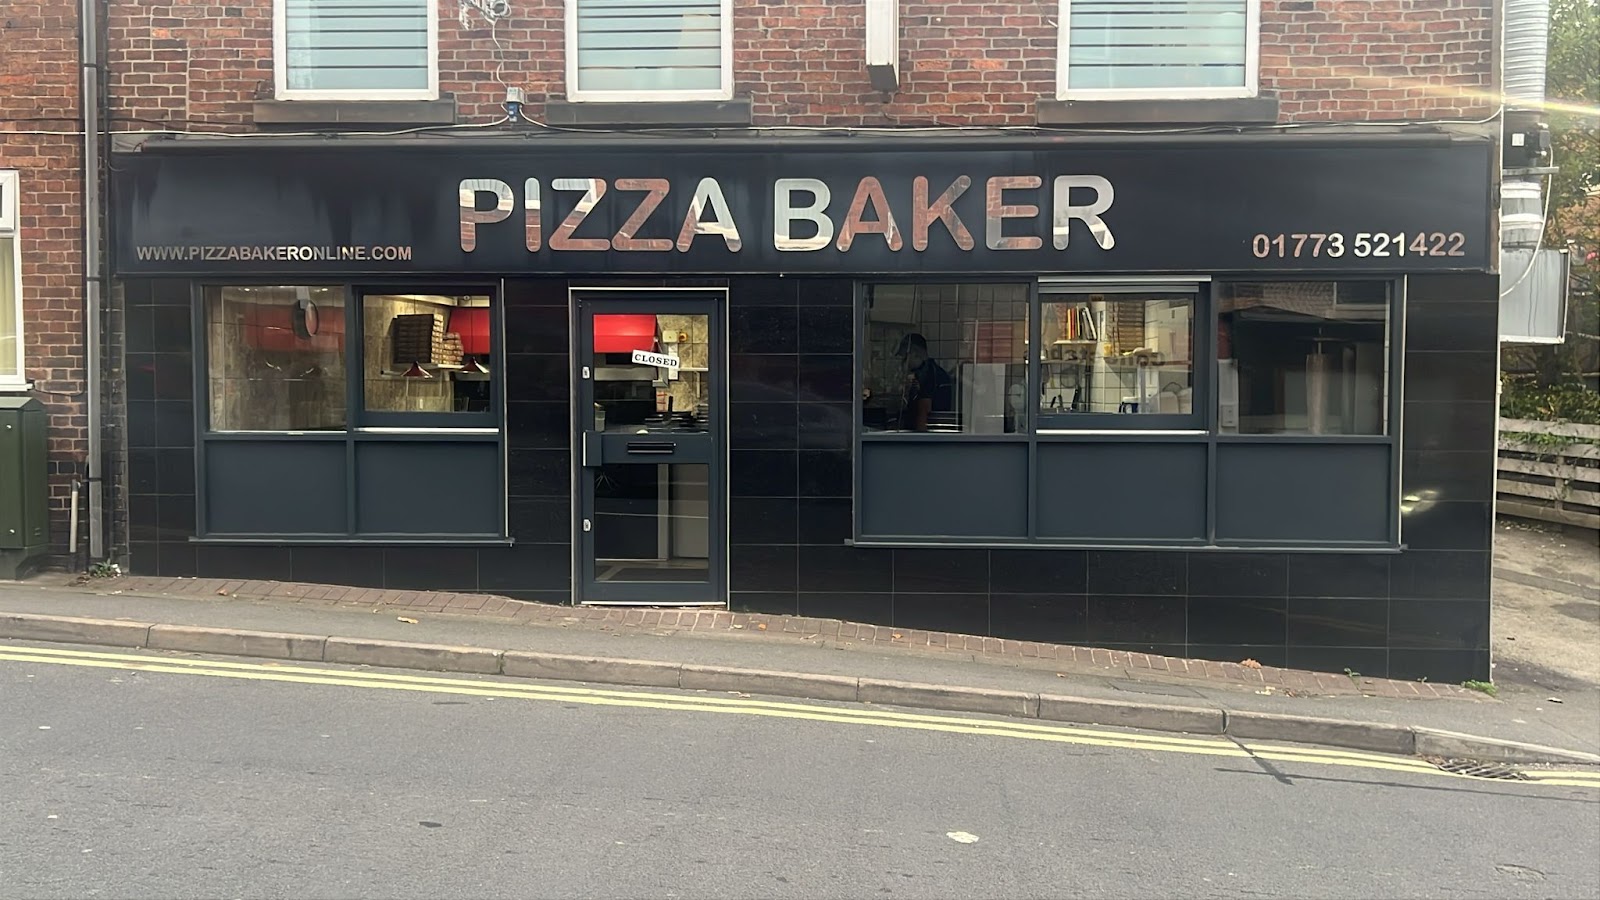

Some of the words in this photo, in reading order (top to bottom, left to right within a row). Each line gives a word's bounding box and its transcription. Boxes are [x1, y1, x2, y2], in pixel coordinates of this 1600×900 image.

[459, 177, 743, 253] PIZZA
[773, 174, 1116, 252] BAKER
[136, 246, 412, 261] WWW.PIZZABAKERONLINE.COM
[1252, 233, 1345, 258] 01773
[1353, 232, 1466, 257] 521422
[634, 353, 677, 366] CLOSED
